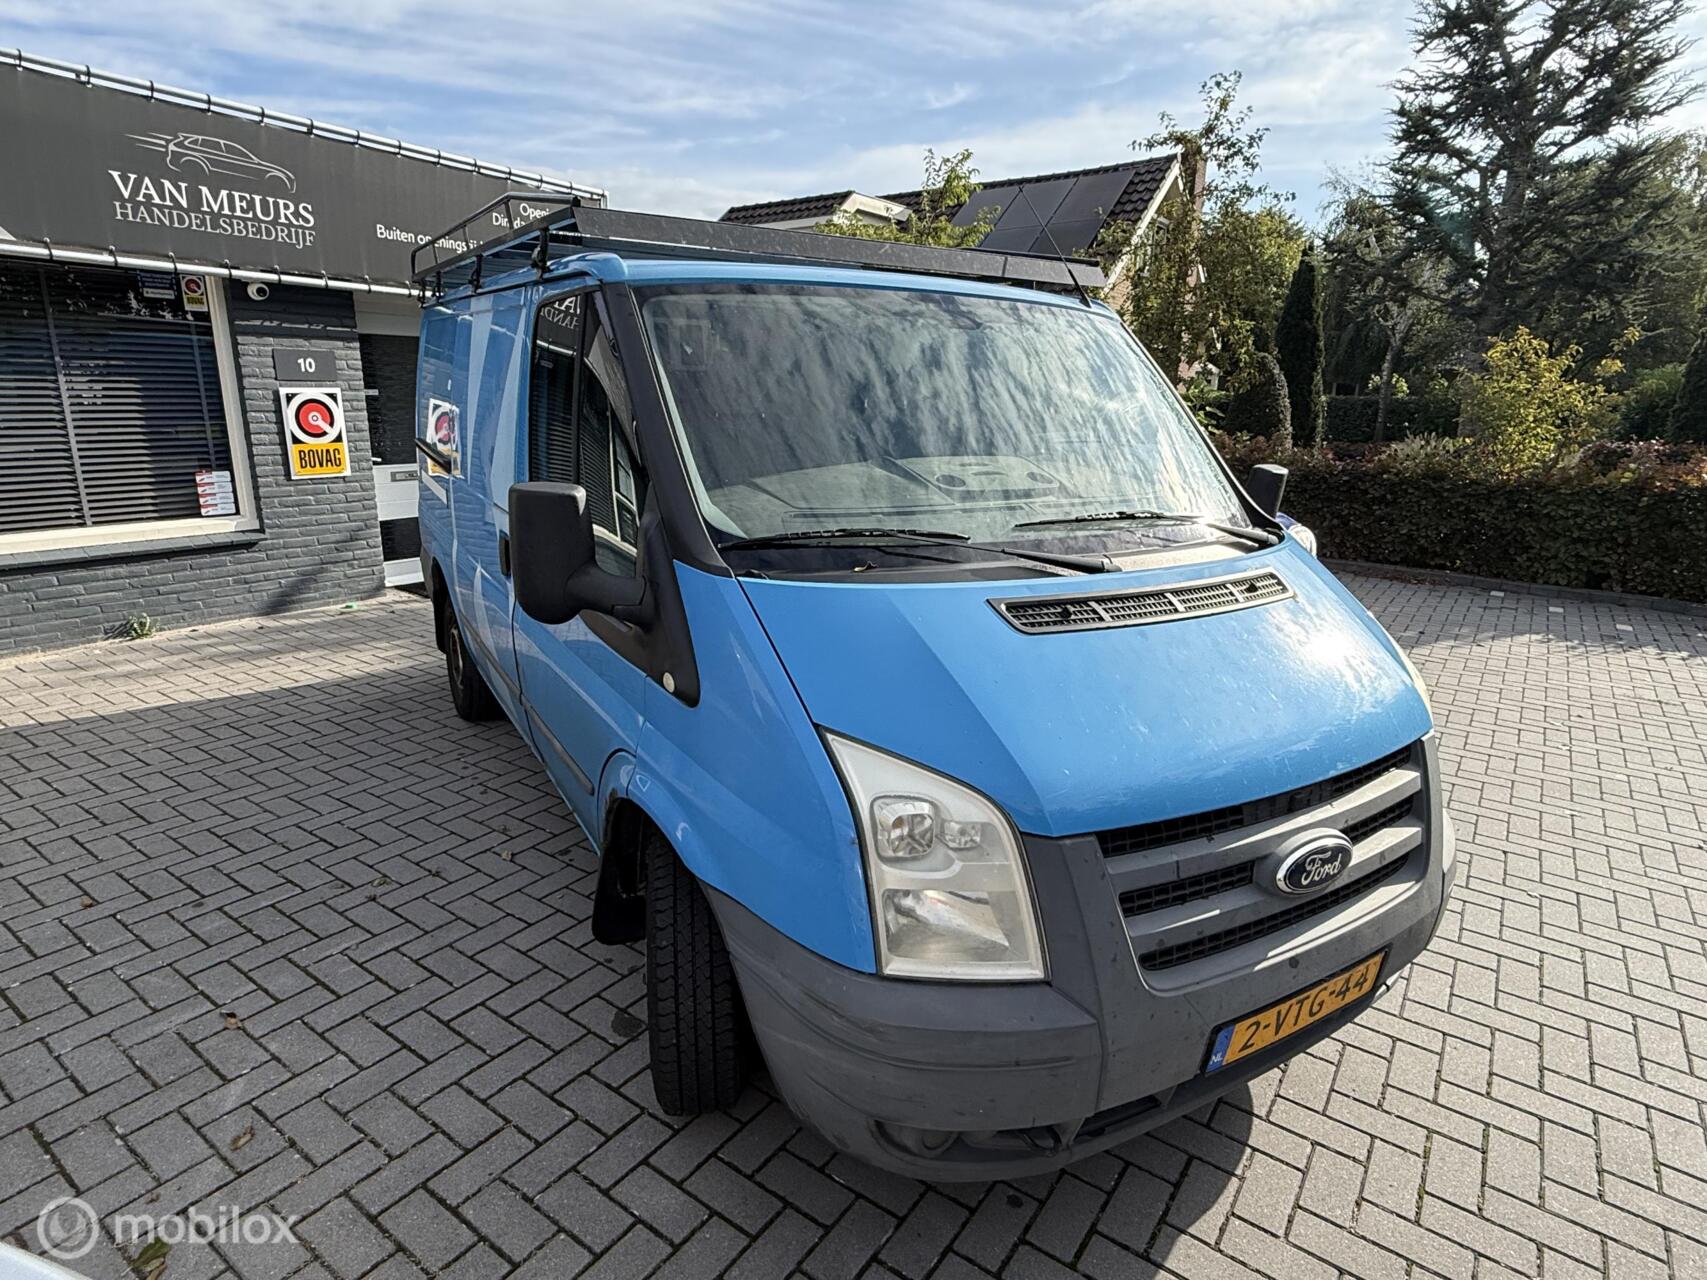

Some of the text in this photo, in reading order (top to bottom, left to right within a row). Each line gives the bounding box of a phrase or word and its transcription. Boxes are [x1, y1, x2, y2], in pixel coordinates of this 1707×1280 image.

[108, 169, 315, 227] VAN MEURS
[113, 201, 316, 249] HANDELSBEDRIJF
[376, 223, 415, 243] Buiten
[297, 357, 316, 373] 10
[298, 447, 342, 469] BOVAG
[1301, 850, 1342, 886] Ford
[1238, 966, 1370, 1053] 2-VTG-44
